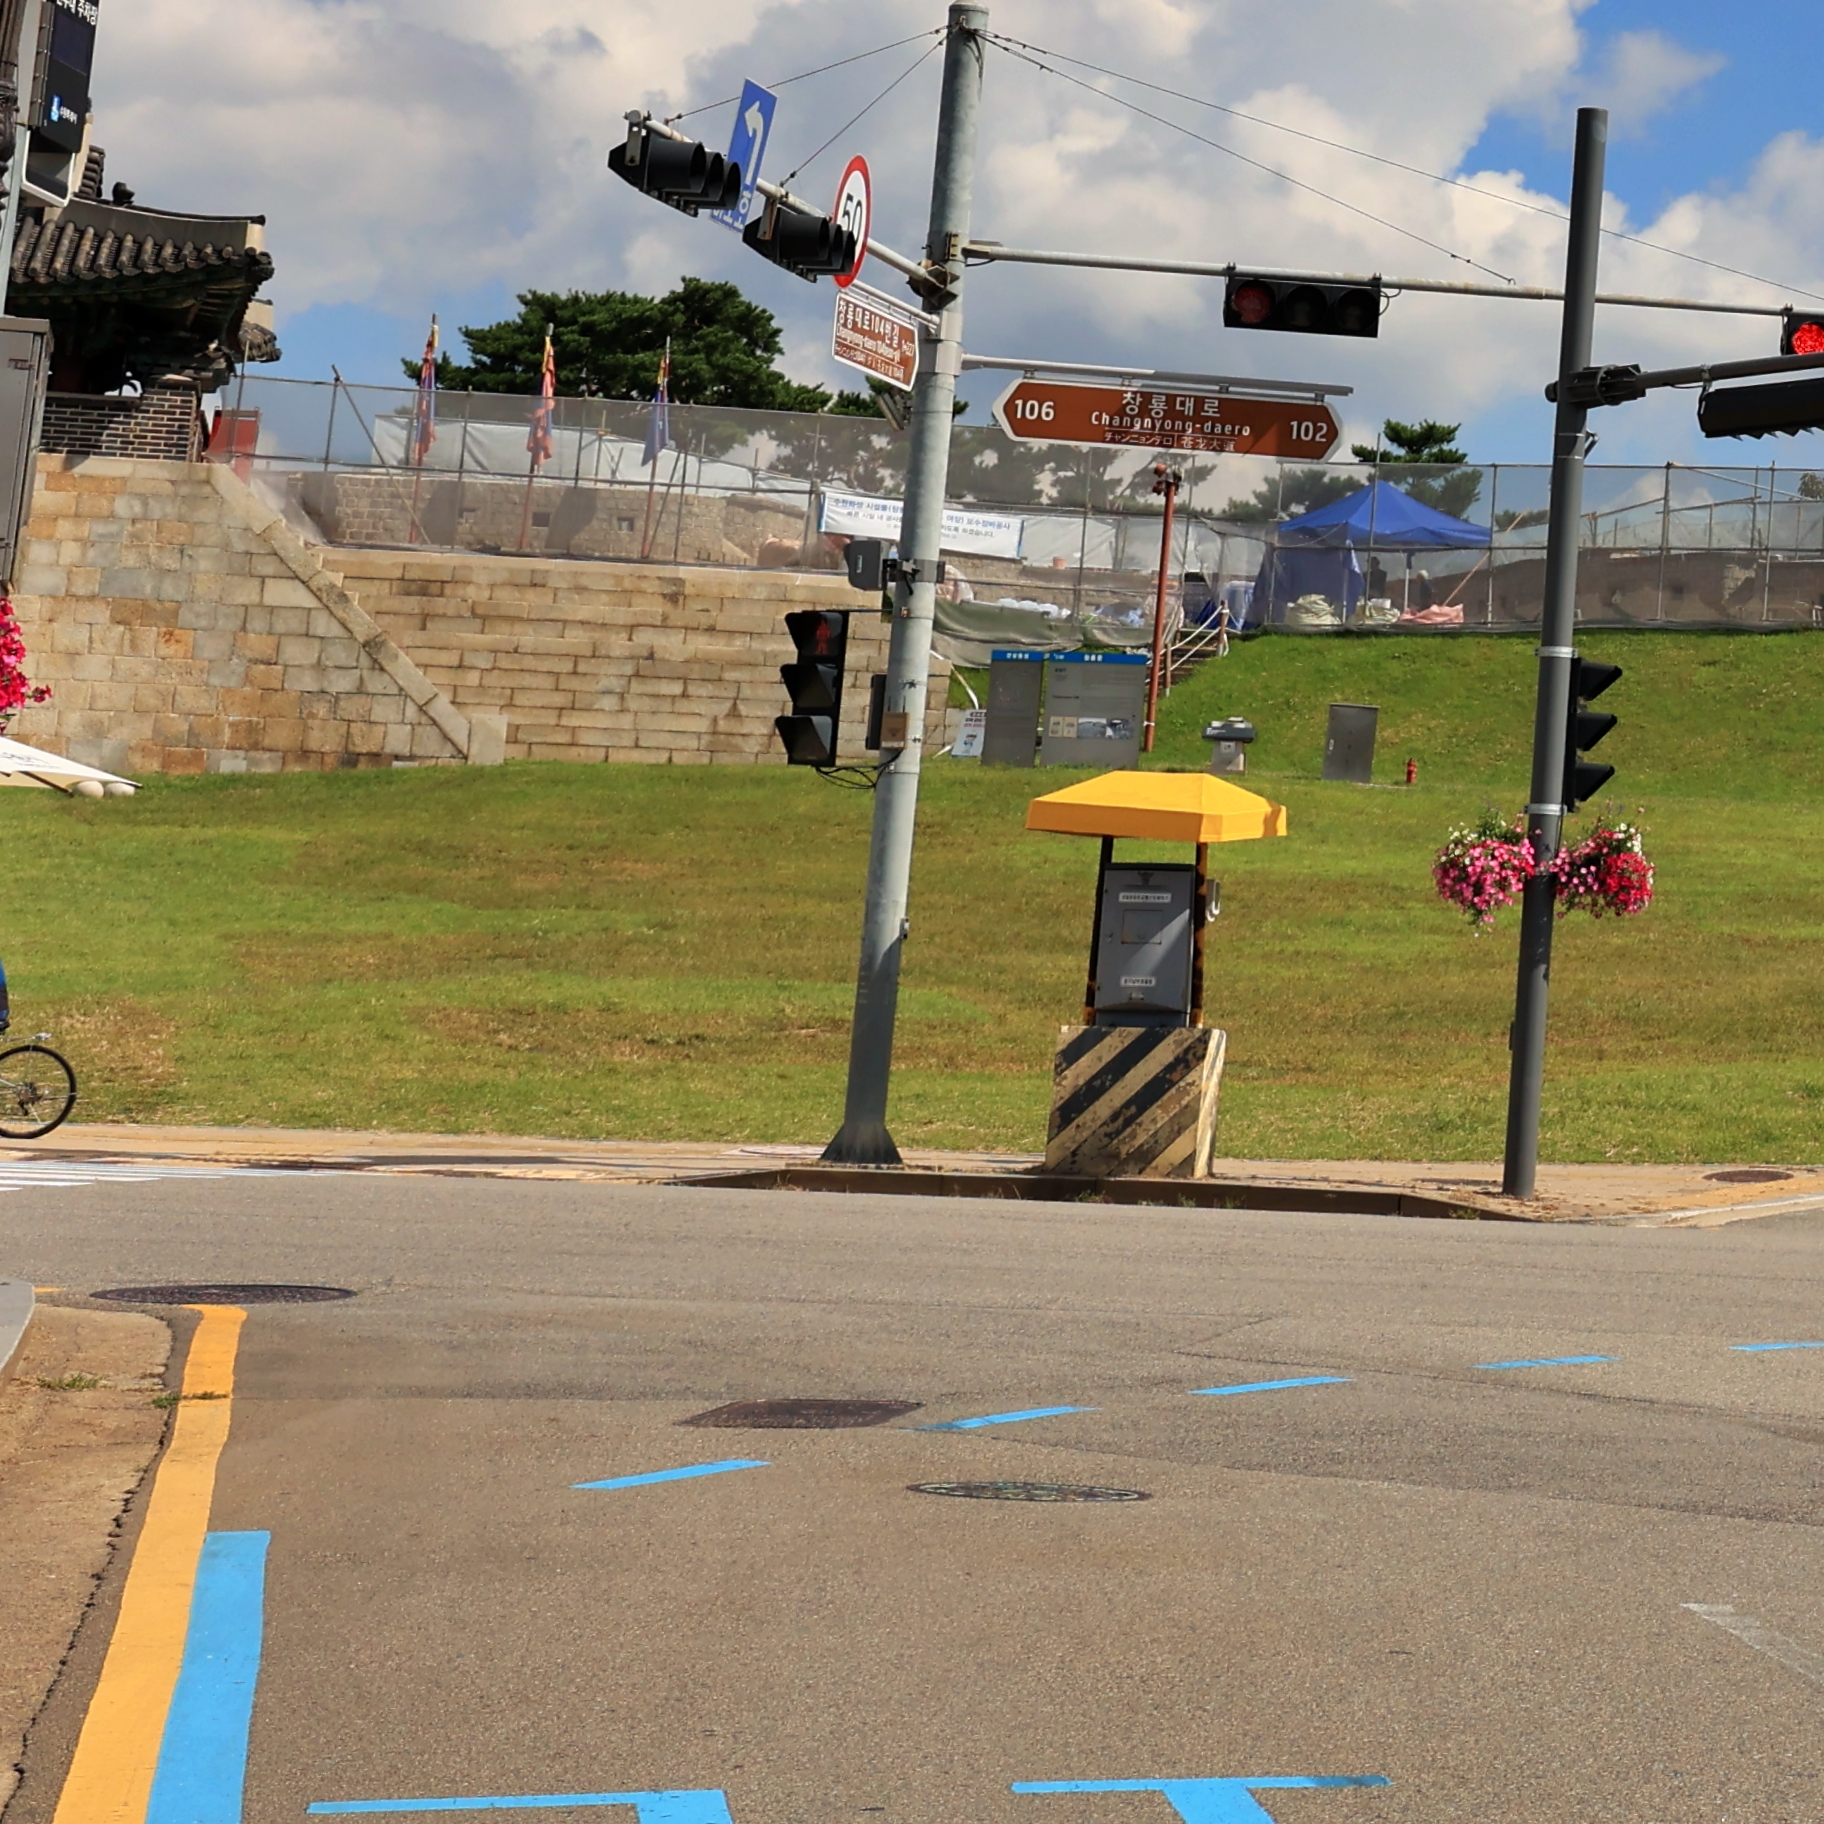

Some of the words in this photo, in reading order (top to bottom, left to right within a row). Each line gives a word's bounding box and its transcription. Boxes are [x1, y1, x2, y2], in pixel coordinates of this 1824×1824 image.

[842, 191, 863, 247] 50
[1014, 398, 1055, 422] 106
[1121, 391, 1221, 418] 창룡대로
[1091, 411, 1251, 436] Changnyong-daero
[1289, 420, 1328, 442] 102
